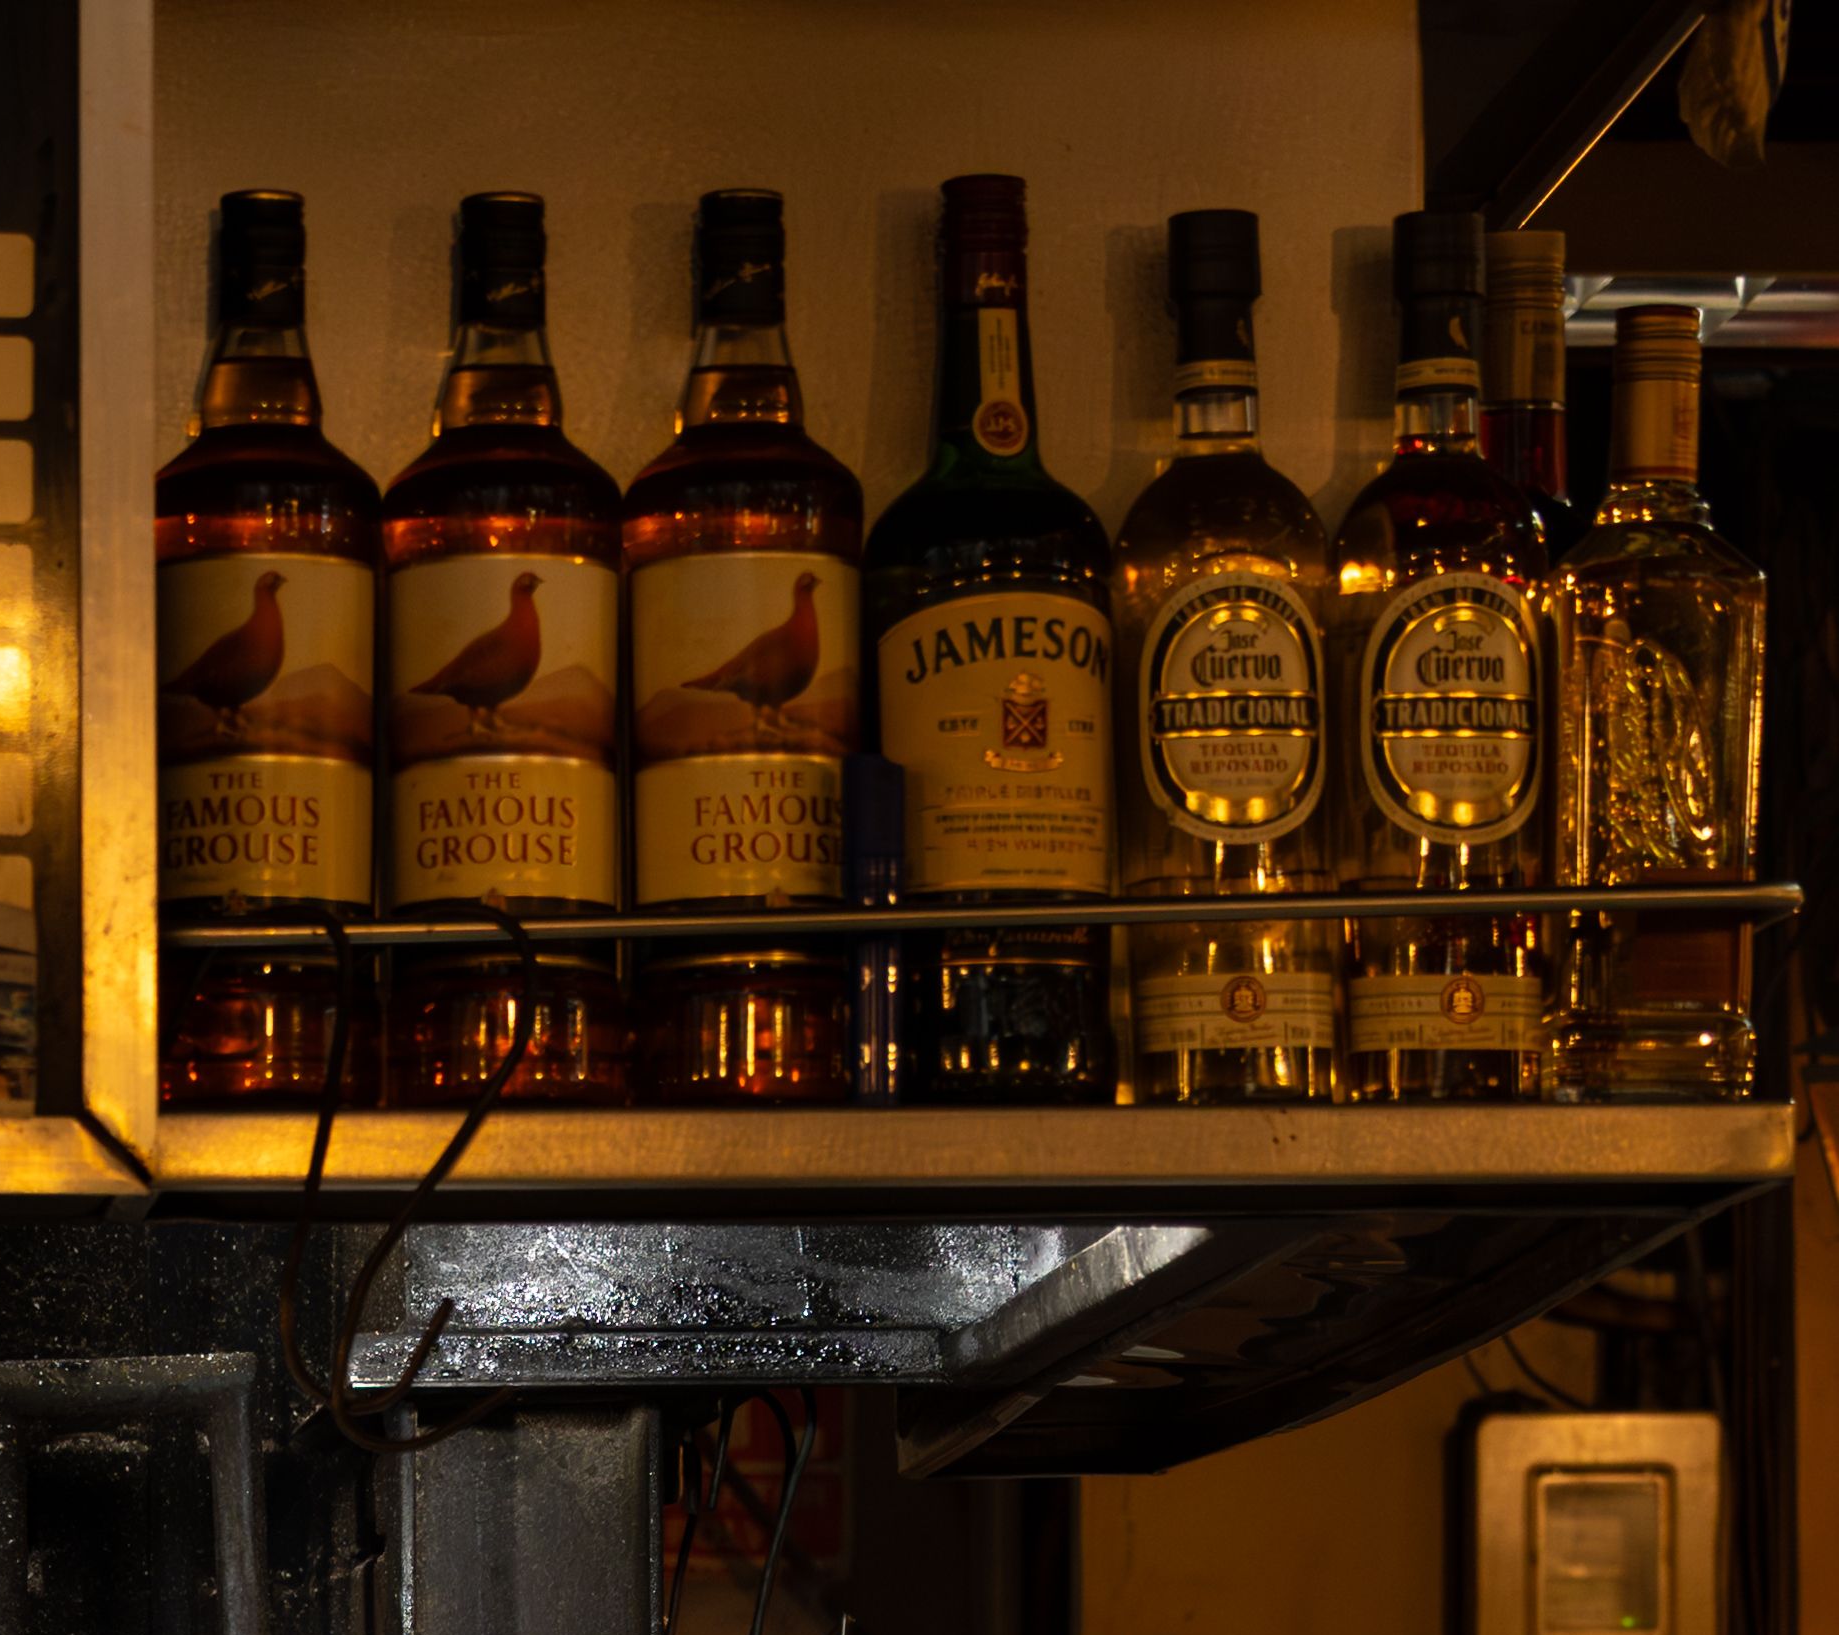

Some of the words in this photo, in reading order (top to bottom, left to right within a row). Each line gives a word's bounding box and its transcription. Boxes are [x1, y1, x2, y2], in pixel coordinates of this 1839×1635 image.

[905, 616, 1107, 684] JAMESON
[1190, 643, 1283, 687] Cuervo
[1416, 644, 1506, 688] Cuervo
[1161, 698, 1311, 727] TRADICIONAL
[1383, 698, 1531, 730] TRADICIONAL
[1198, 743, 1279, 757] TEQUILA
[209, 772, 263, 790] THE
[467, 771, 522, 790] THE
[750, 770, 804, 788] THE
[1189, 759, 1289, 775] REPOSADO
[1412, 759, 1509, 775] REPOSADO
[165, 795, 321, 831] FAMOUS
[418, 794, 575, 832] FAMOUS
[417, 832, 574, 869] GROUSE
